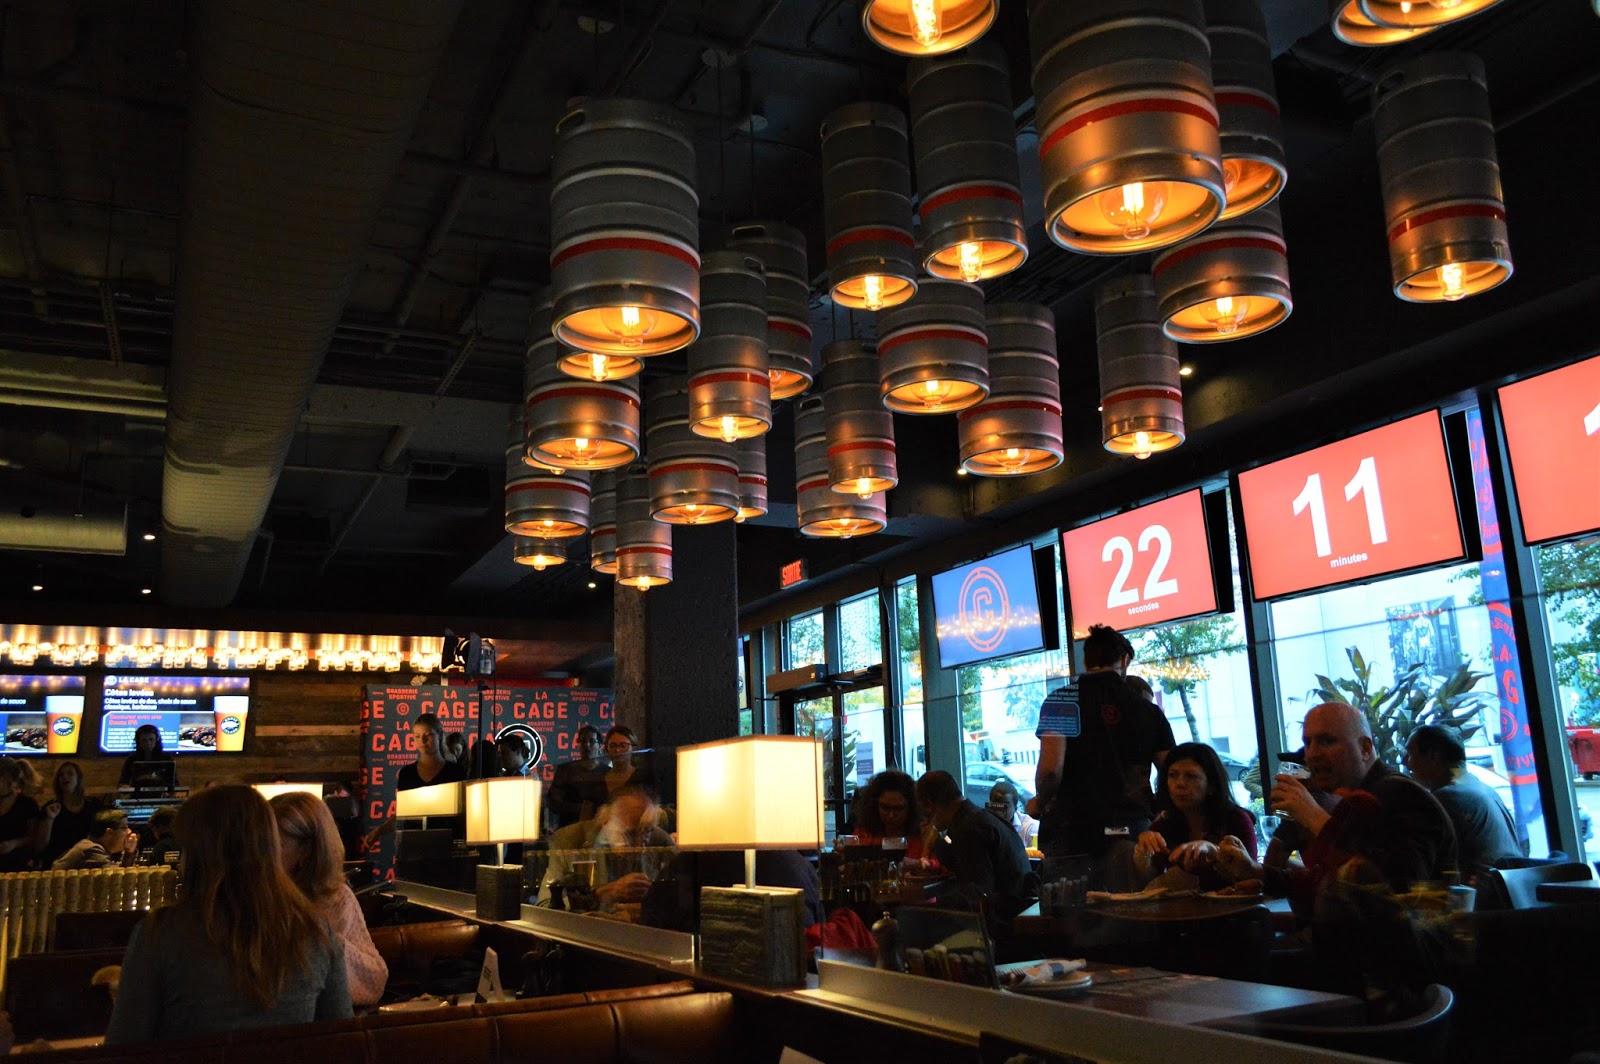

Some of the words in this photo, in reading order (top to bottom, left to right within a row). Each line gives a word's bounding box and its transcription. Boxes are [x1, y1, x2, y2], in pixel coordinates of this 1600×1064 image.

[1292, 456, 1388, 558] 11
[1102, 524, 1179, 609] 22
[1330, 552, 1369, 568] minutes
[782, 560, 803, 587] SORTIE
[1127, 601, 1160, 615] secondes
[443, 689, 458, 699] LA
[535, 691, 548, 700] LA
[421, 700, 480, 719] CAGE
[513, 702, 568, 719] CAGE
[396, 721, 411, 731] LA
[372, 733, 418, 752] CAG
